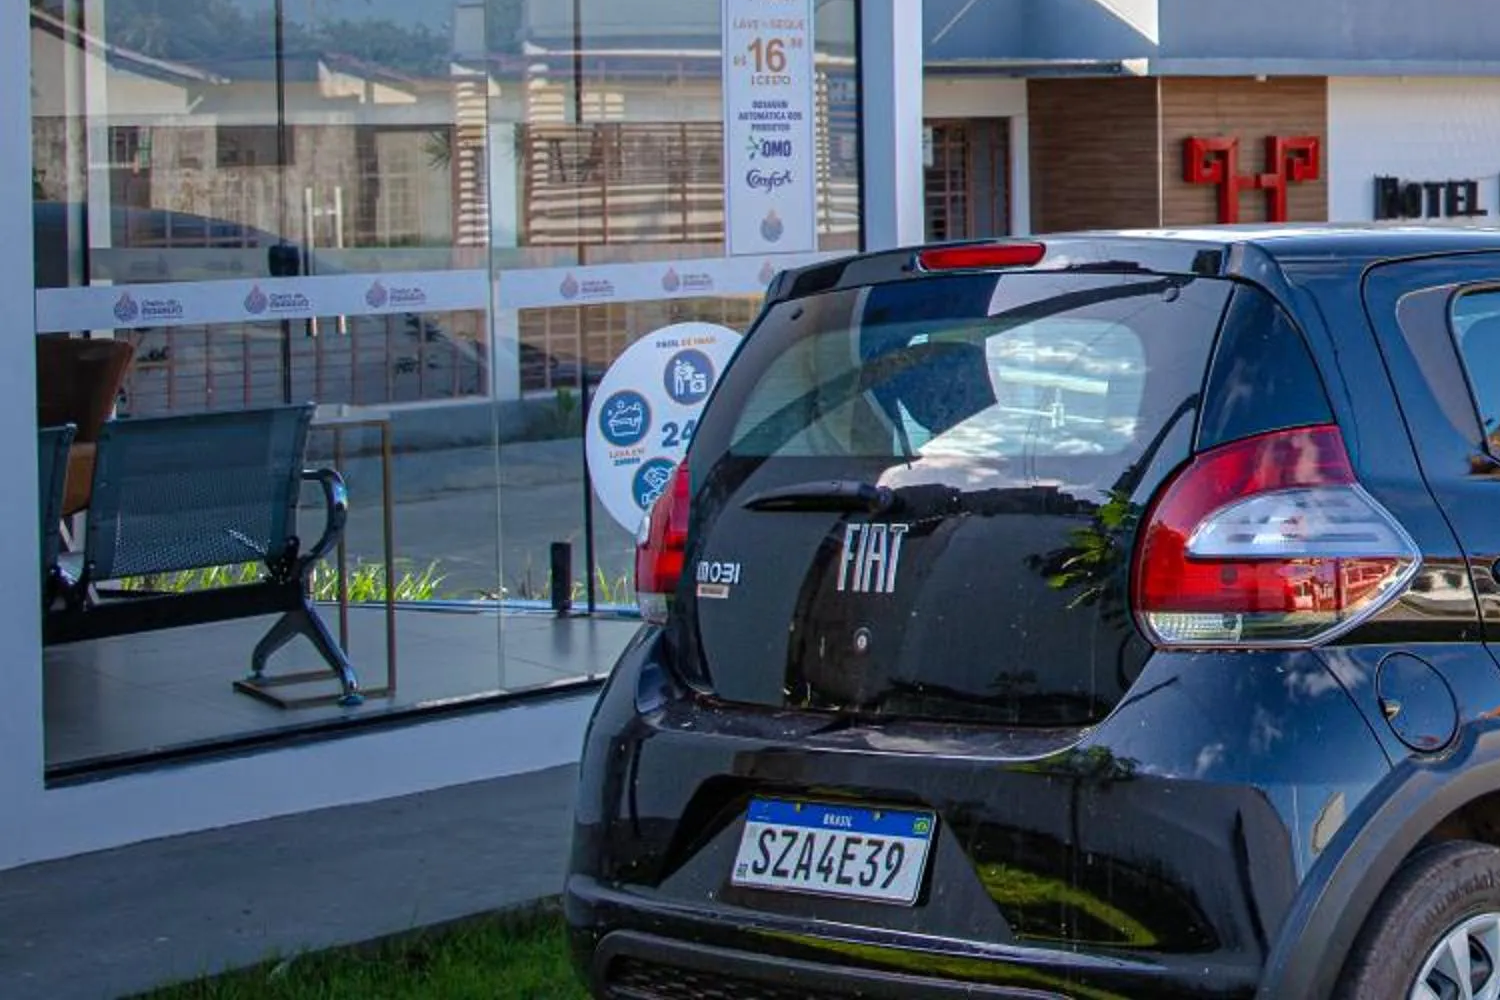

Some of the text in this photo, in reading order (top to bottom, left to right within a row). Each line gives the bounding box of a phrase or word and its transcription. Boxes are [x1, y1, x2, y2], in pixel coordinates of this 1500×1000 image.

[747, 36, 787, 74] 16
[762, 139, 793, 158] OMO
[1373, 174, 1488, 221] HOTEL
[836, 522, 909, 593] FIAT
[752, 828, 905, 889] SZA4E39
